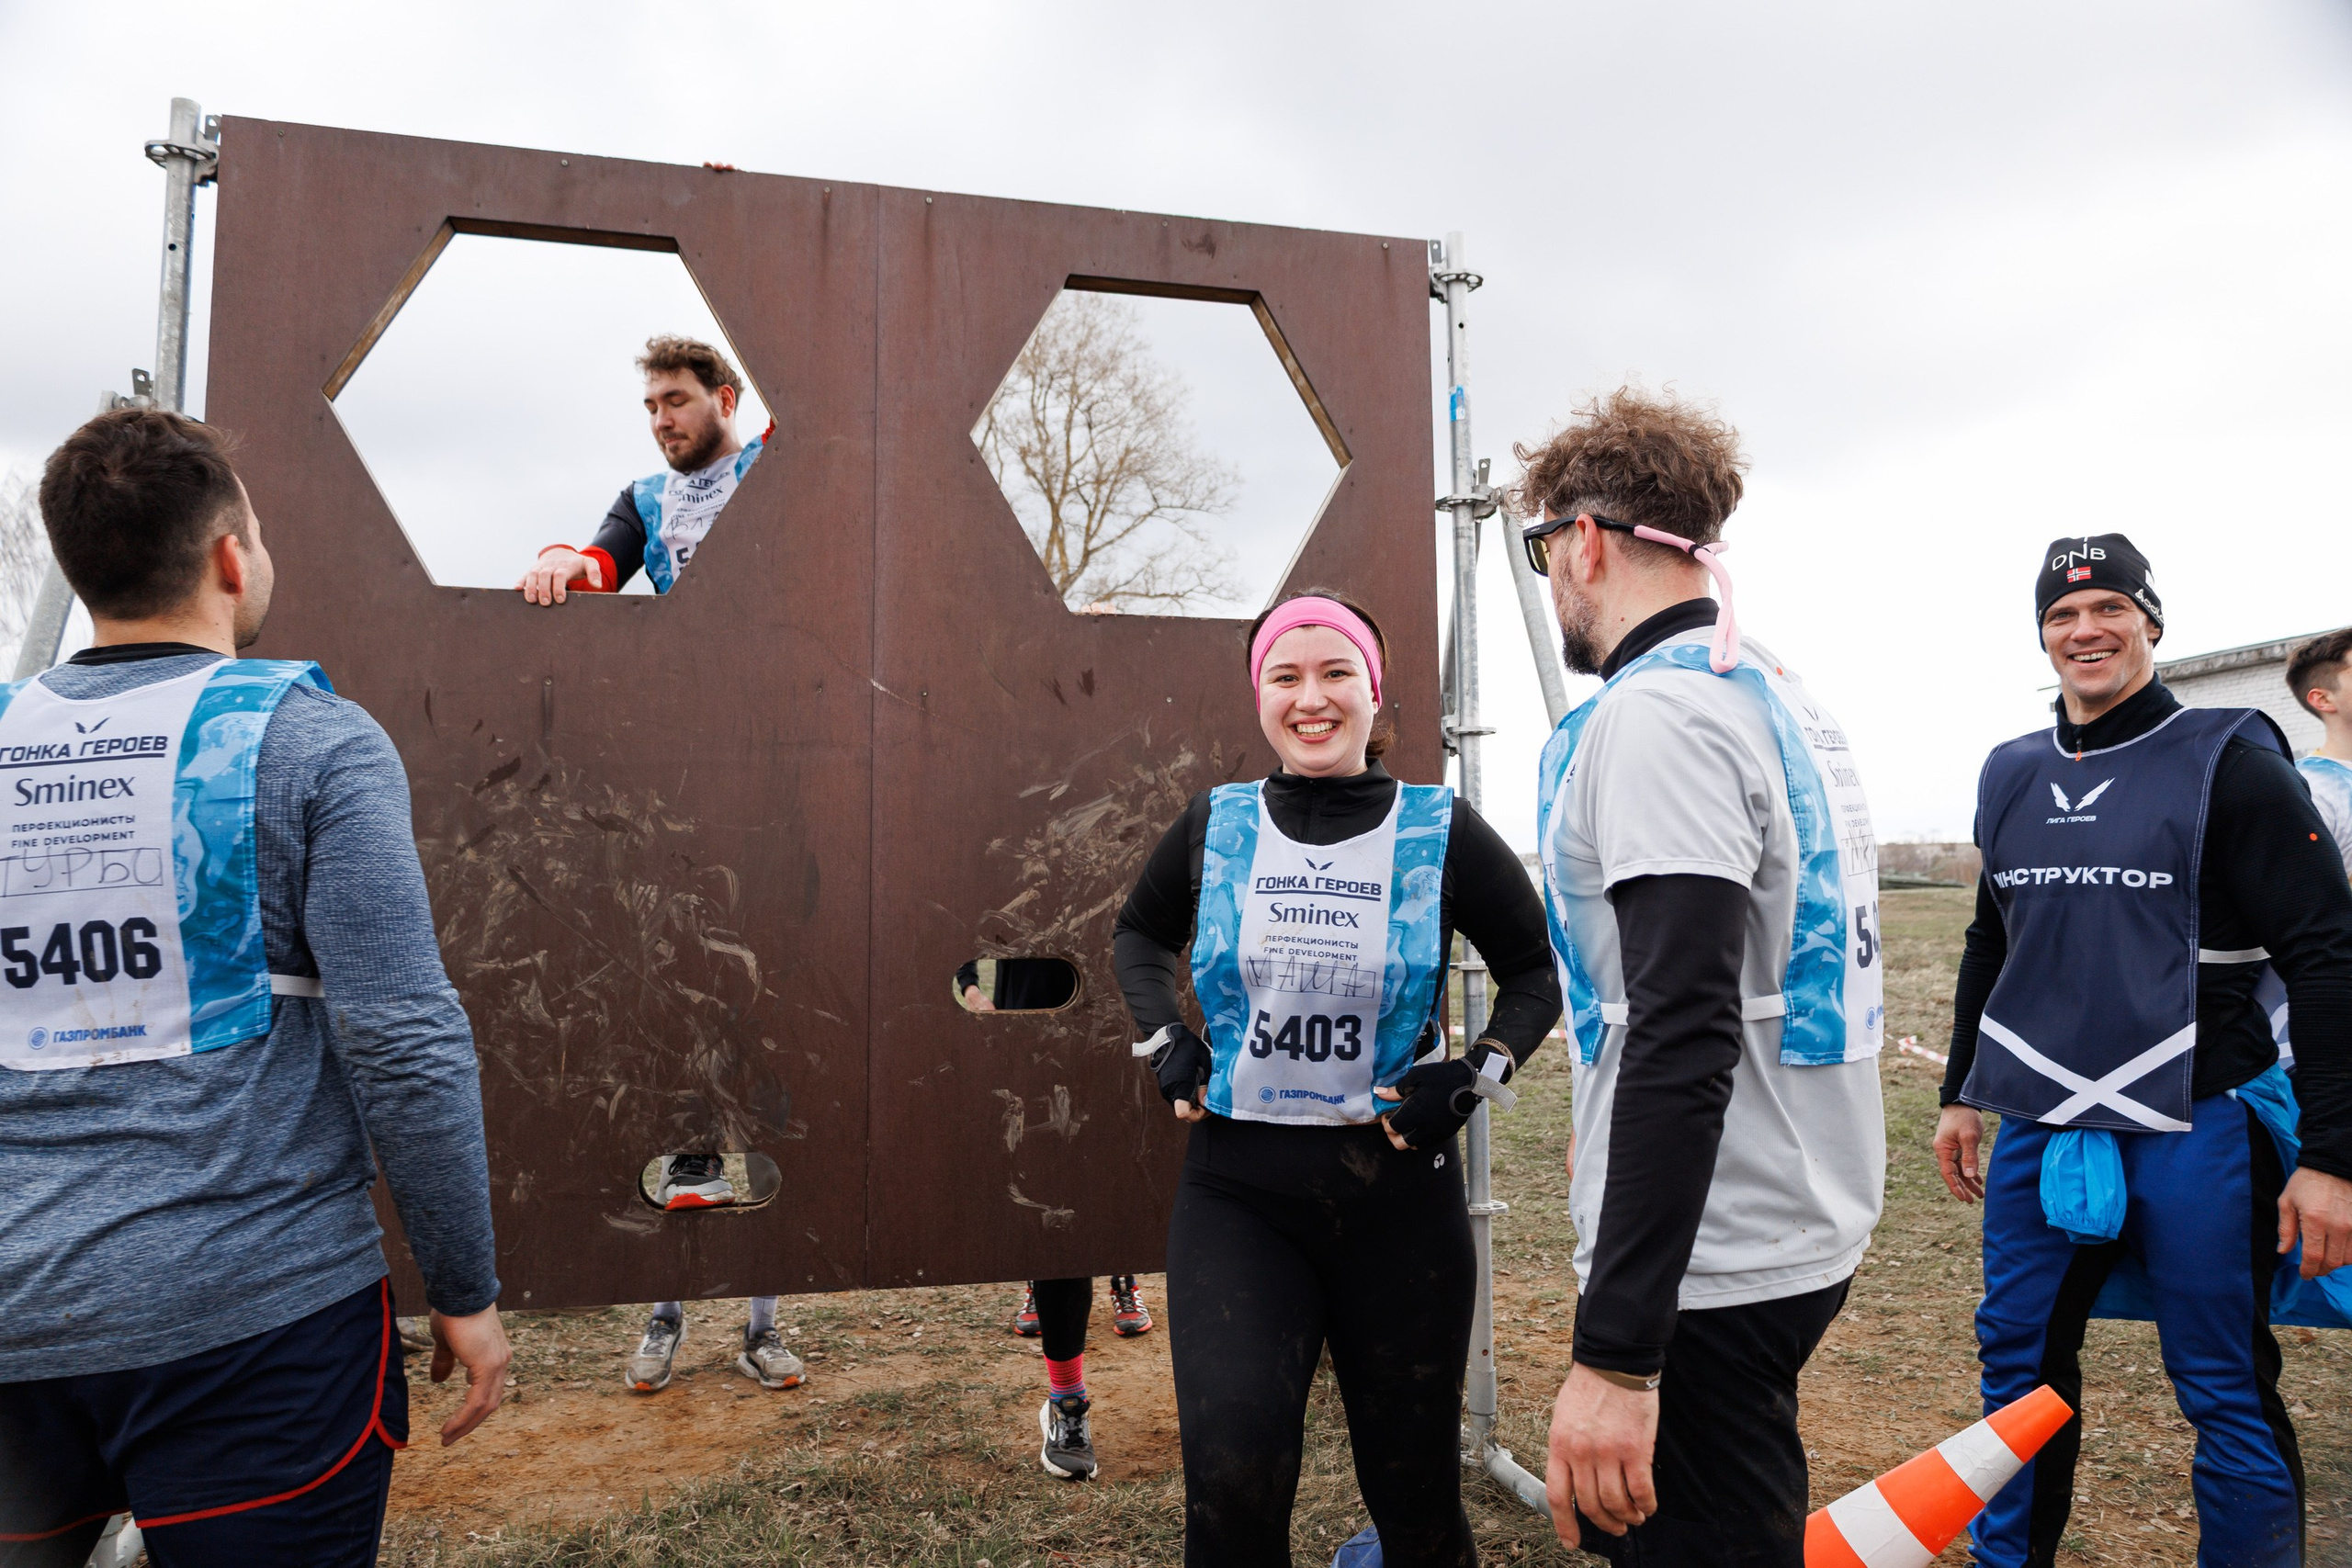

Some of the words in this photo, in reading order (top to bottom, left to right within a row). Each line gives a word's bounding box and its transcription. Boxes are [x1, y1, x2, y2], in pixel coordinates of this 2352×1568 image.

[2052, 543, 2107, 571] DNB
[0, 743, 71, 763] ГОНКА
[79, 735, 168, 756] ГЕРОЕВ
[14, 774, 136, 807] Sminex
[11, 814, 136, 833] ПЕРФЕКЦИОНИСТЫ
[2045, 816, 2066, 825] ЛИГА
[2066, 815, 2098, 823] ГЕРОЕВ
[11, 838, 39, 849] FINE
[43, 830, 136, 847] DEVELOPMENT
[1256, 875, 1309, 889] ГОНКА
[1315, 876, 1382, 897] ГЕРОЕВ
[1268, 902, 1360, 929] Sminex
[1265, 935, 1359, 950] ПЕРФЕКЦИОНИСТЫ
[0, 917, 163, 989] 5406
[1263, 946, 1284, 954] FINE
[1288, 948, 1358, 962] DEVELOPMENT
[52, 1024, 147, 1043] ГАЗПРОМБАНК
[1250, 1009, 1362, 1062] 5403
[1279, 1089, 1346, 1105] ГАЗПРОМБАНК
